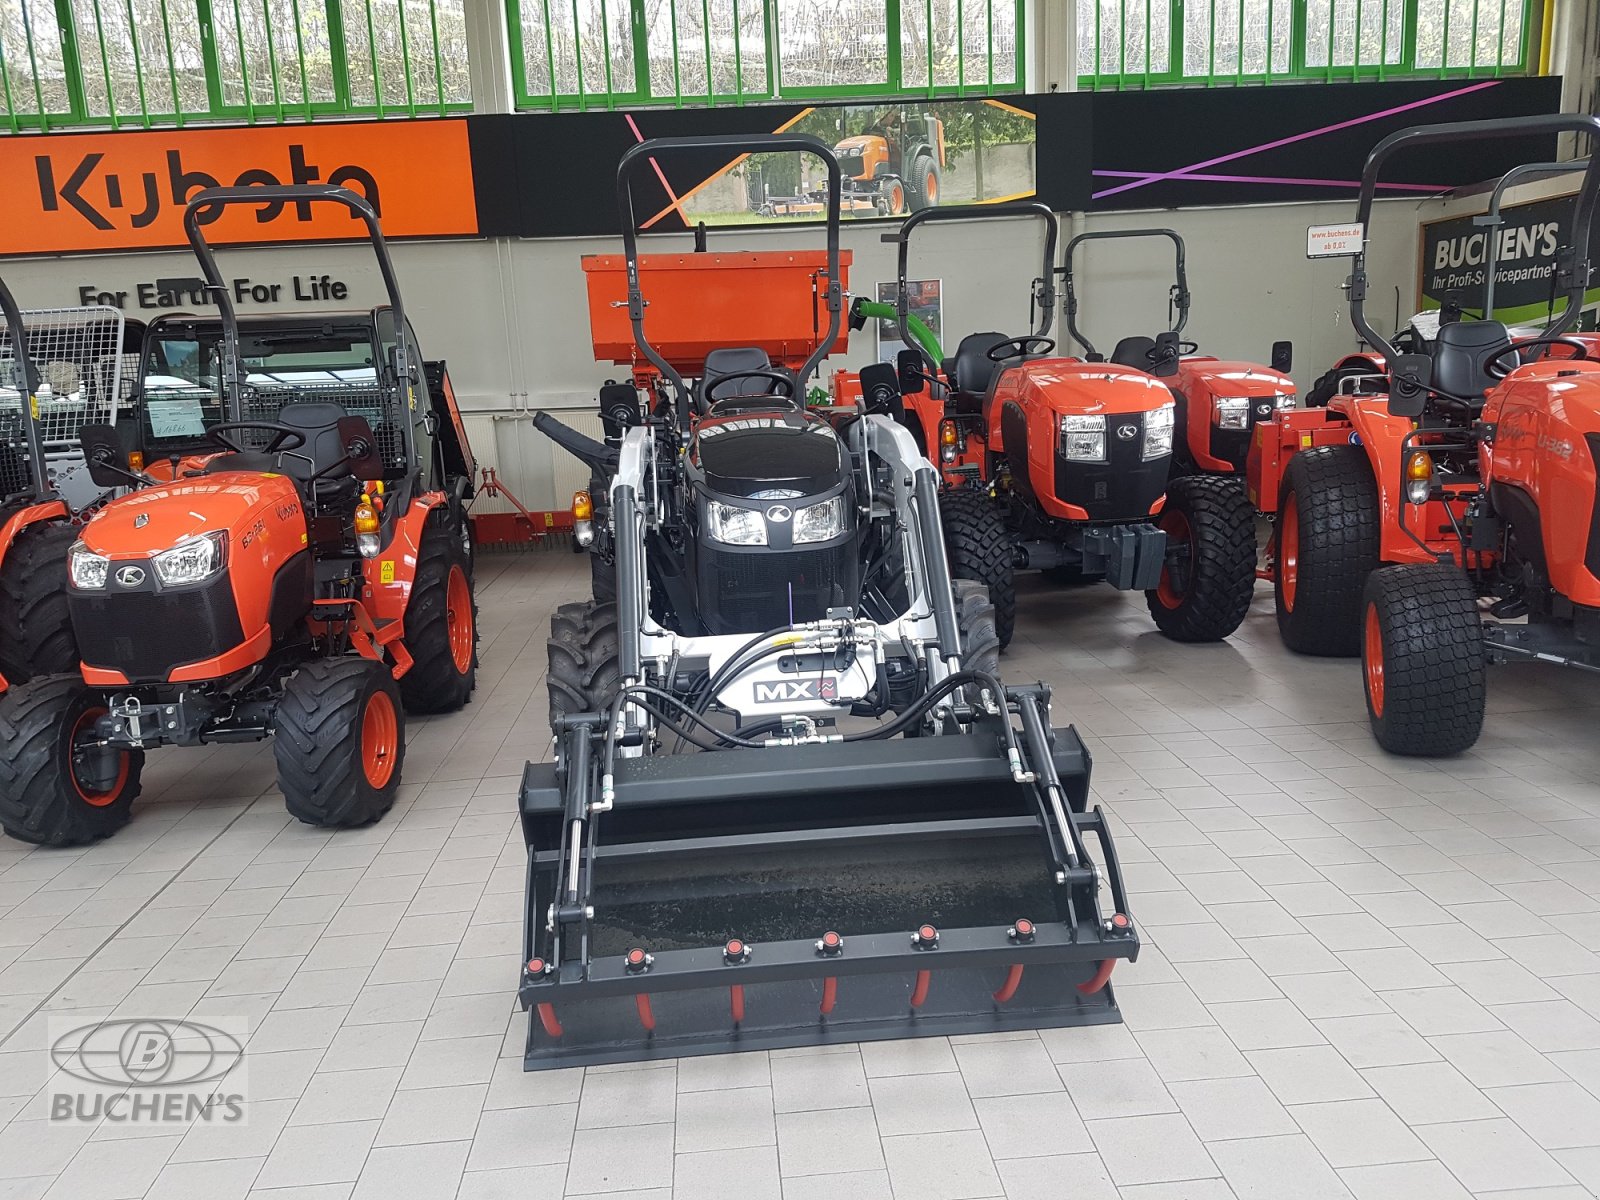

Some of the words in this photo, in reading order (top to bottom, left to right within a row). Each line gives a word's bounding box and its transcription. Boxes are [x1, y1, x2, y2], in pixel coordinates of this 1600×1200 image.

[35, 144, 382, 231] Kubota
[79, 286, 127, 309] For
[234, 278, 281, 304] For
[293, 275, 348, 301] Life
[1432, 275, 1447, 290] Ihr
[756, 681, 815, 701] MX
